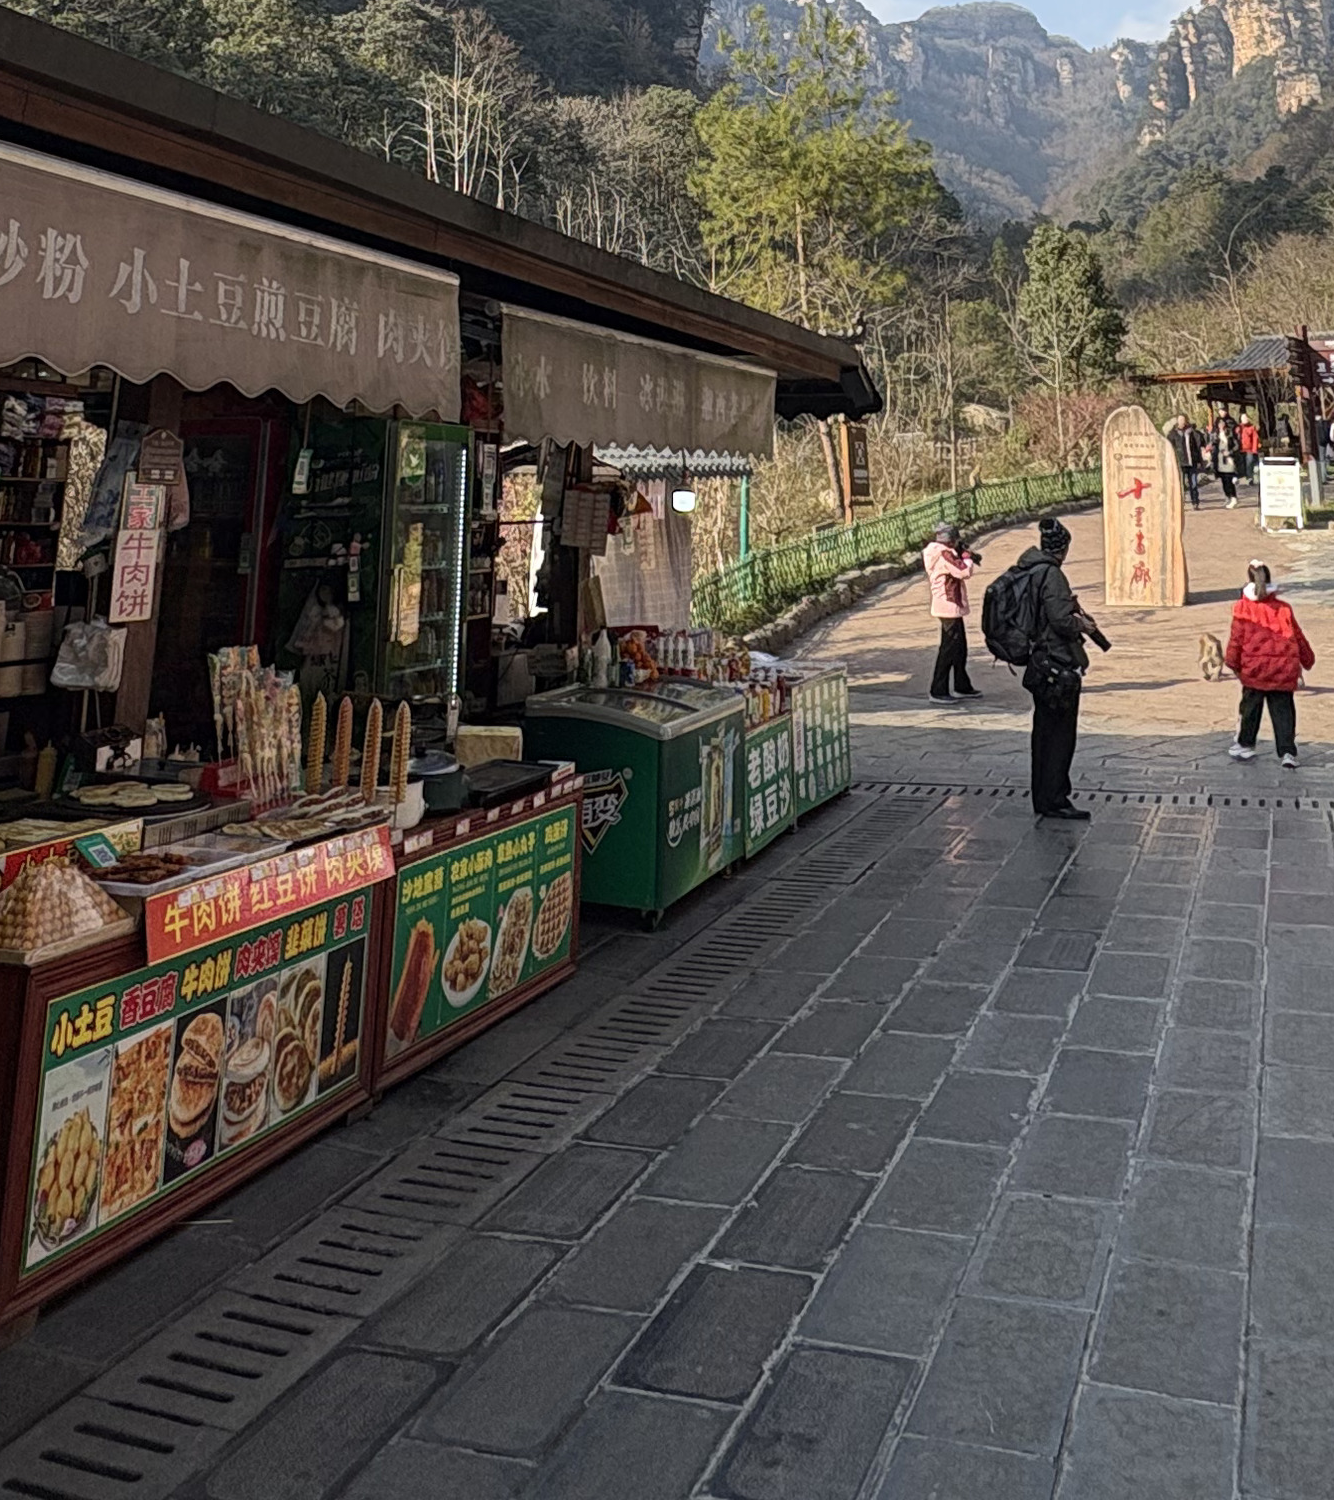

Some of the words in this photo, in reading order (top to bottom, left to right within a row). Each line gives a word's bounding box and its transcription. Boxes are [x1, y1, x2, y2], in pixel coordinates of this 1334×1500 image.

[109, 247, 359, 356] 小土豆煎豆腐
[116, 532, 154, 617] 牛肉饼
[747, 730, 789, 789] 老酸奶
[748, 775, 792, 838] 绿豆沙
[164, 887, 243, 944] 牛肉饼
[250, 863, 318, 912] 红豆饼
[50, 994, 116, 1057] 小土豆
[119, 971, 179, 1032] 香豆腐
[180, 949, 232, 1003] 牛肉饼
[234, 929, 282, 979] 肉夹馍
[284, 911, 328, 961] 韭菜饼
